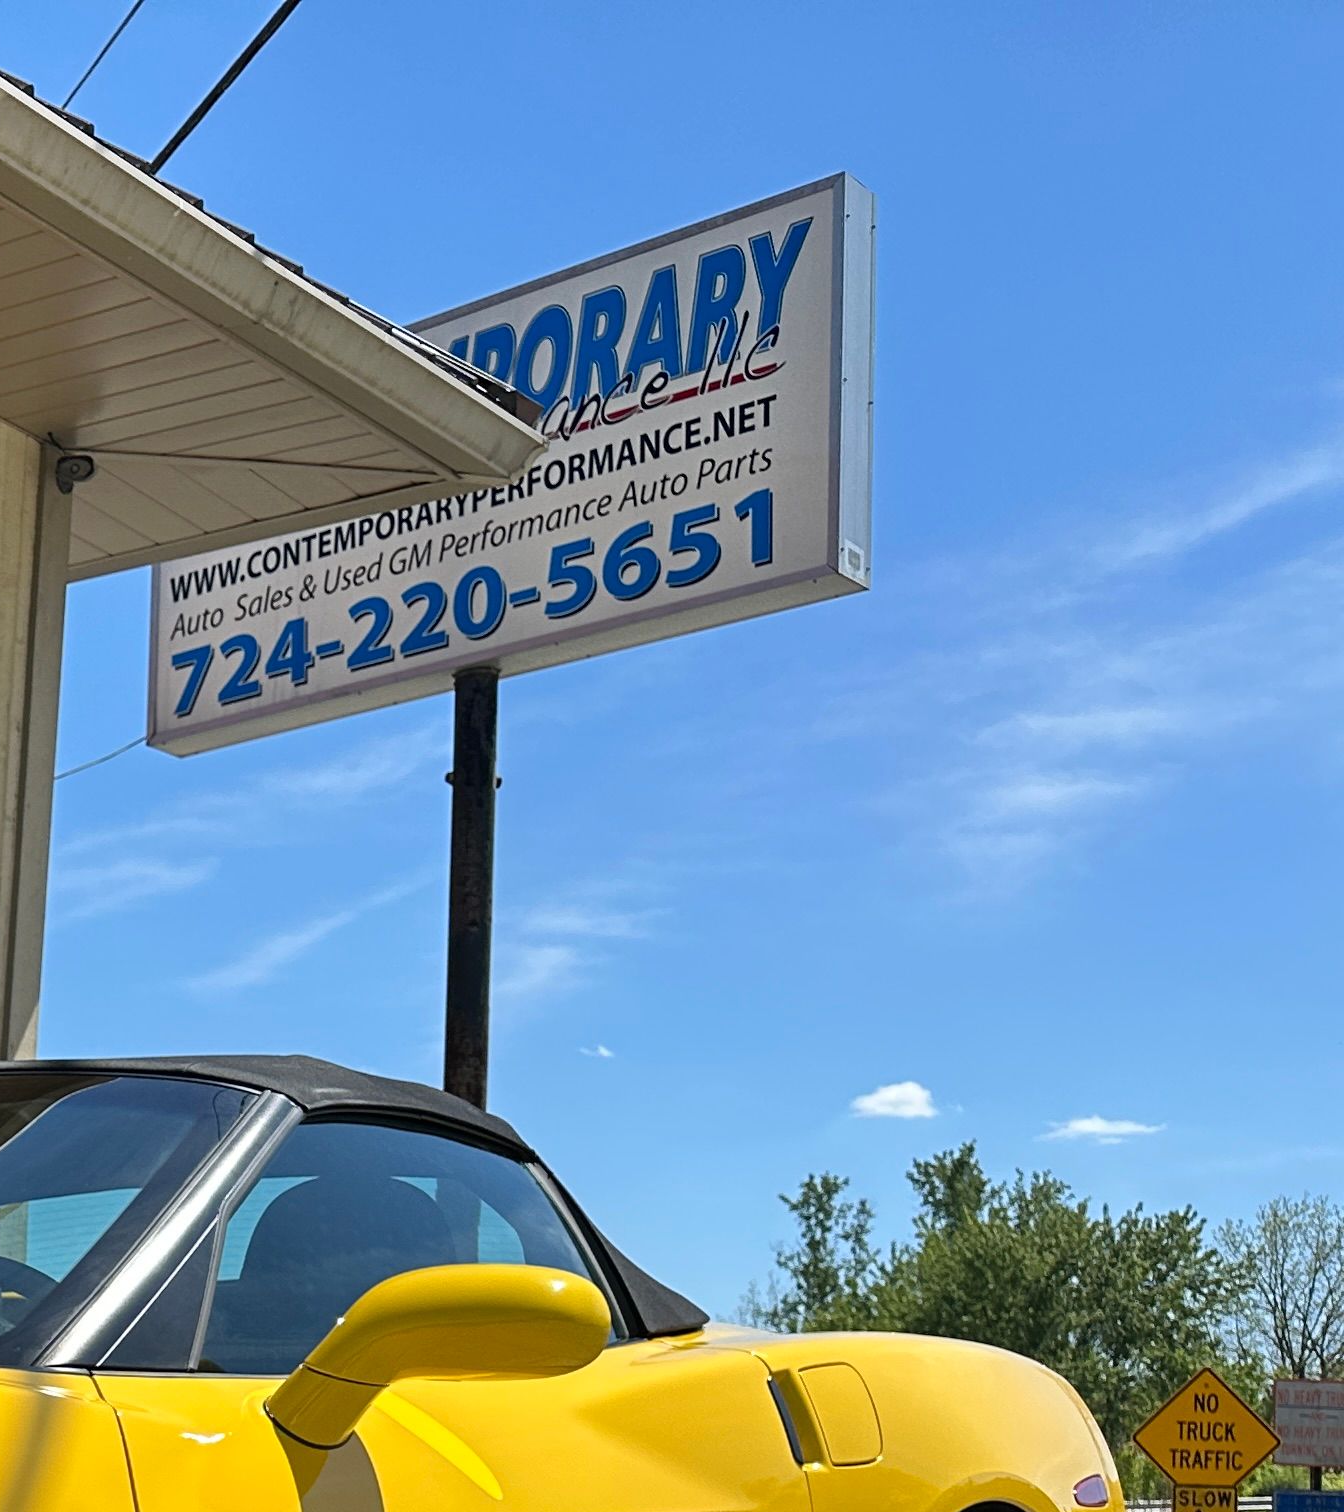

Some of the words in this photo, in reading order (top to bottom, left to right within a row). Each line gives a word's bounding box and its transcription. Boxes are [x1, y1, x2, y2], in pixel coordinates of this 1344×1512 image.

[448, 217, 814, 417] PORARY
[170, 394, 777, 602] WWW.CONTEMPORARYPERFORMANCE.NET
[170, 606, 225, 641] Auto
[235, 584, 293, 621] Sales
[299, 573, 318, 602] &
[324, 553, 384, 596] Used
[389, 539, 433, 576] GM
[439, 494, 612, 564] Performance
[618, 471, 688, 512] Auto
[696, 448, 774, 490] Parts
[170, 488, 776, 718] 724-220-5651
[1176, 1420, 1236, 1442] TRUCK
[1193, 1392, 1219, 1414] NO
[1169, 1447, 1243, 1471] TRAFFIC
[1179, 1489, 1232, 1507] SLOW
